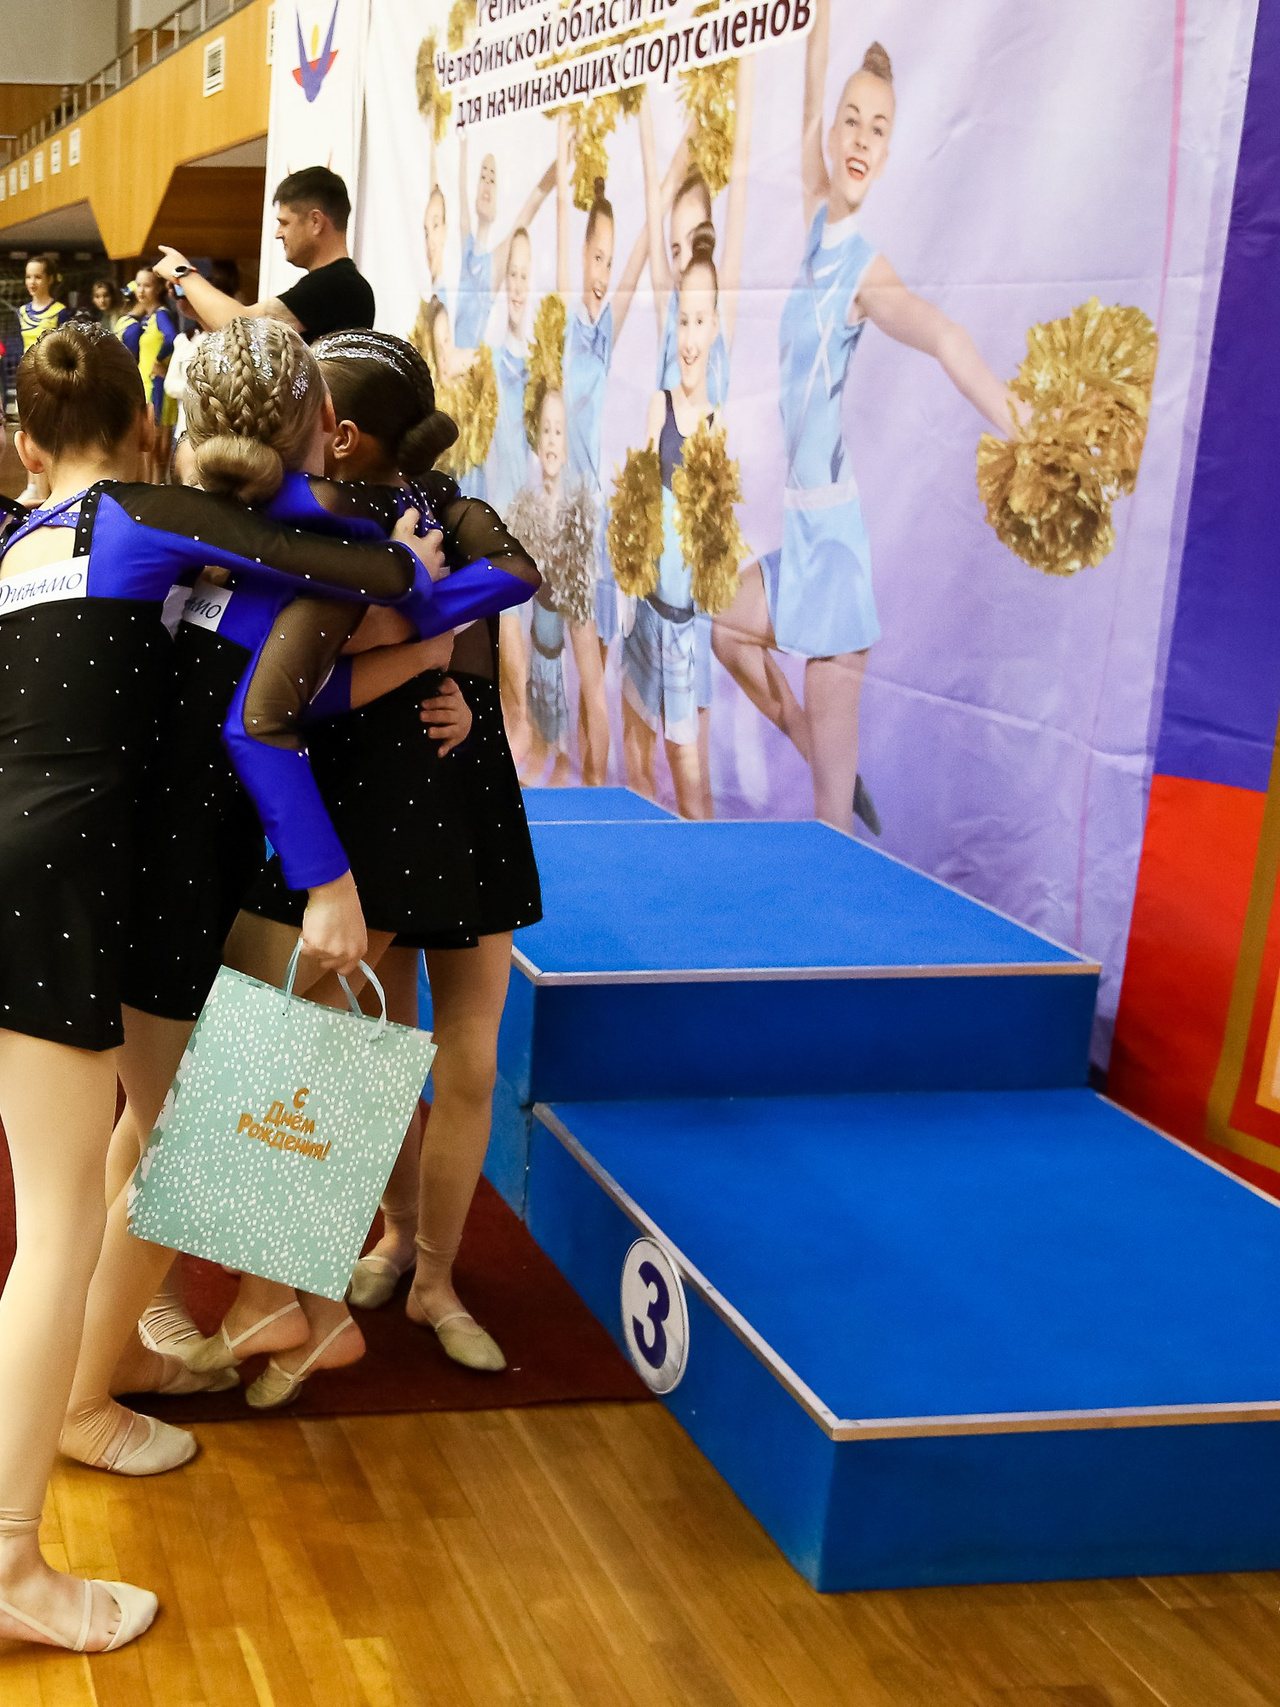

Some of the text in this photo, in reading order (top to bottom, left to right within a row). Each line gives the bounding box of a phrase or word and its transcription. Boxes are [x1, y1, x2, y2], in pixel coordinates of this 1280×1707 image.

[436, 12, 552, 87] Челябинской
[556, 0, 644, 47] области
[486, 53, 618, 120] начинающих
[622, 0, 811, 84] спортсменов
[236, 1113, 332, 1161] Рождения!
[632, 1260, 670, 1370] 3
